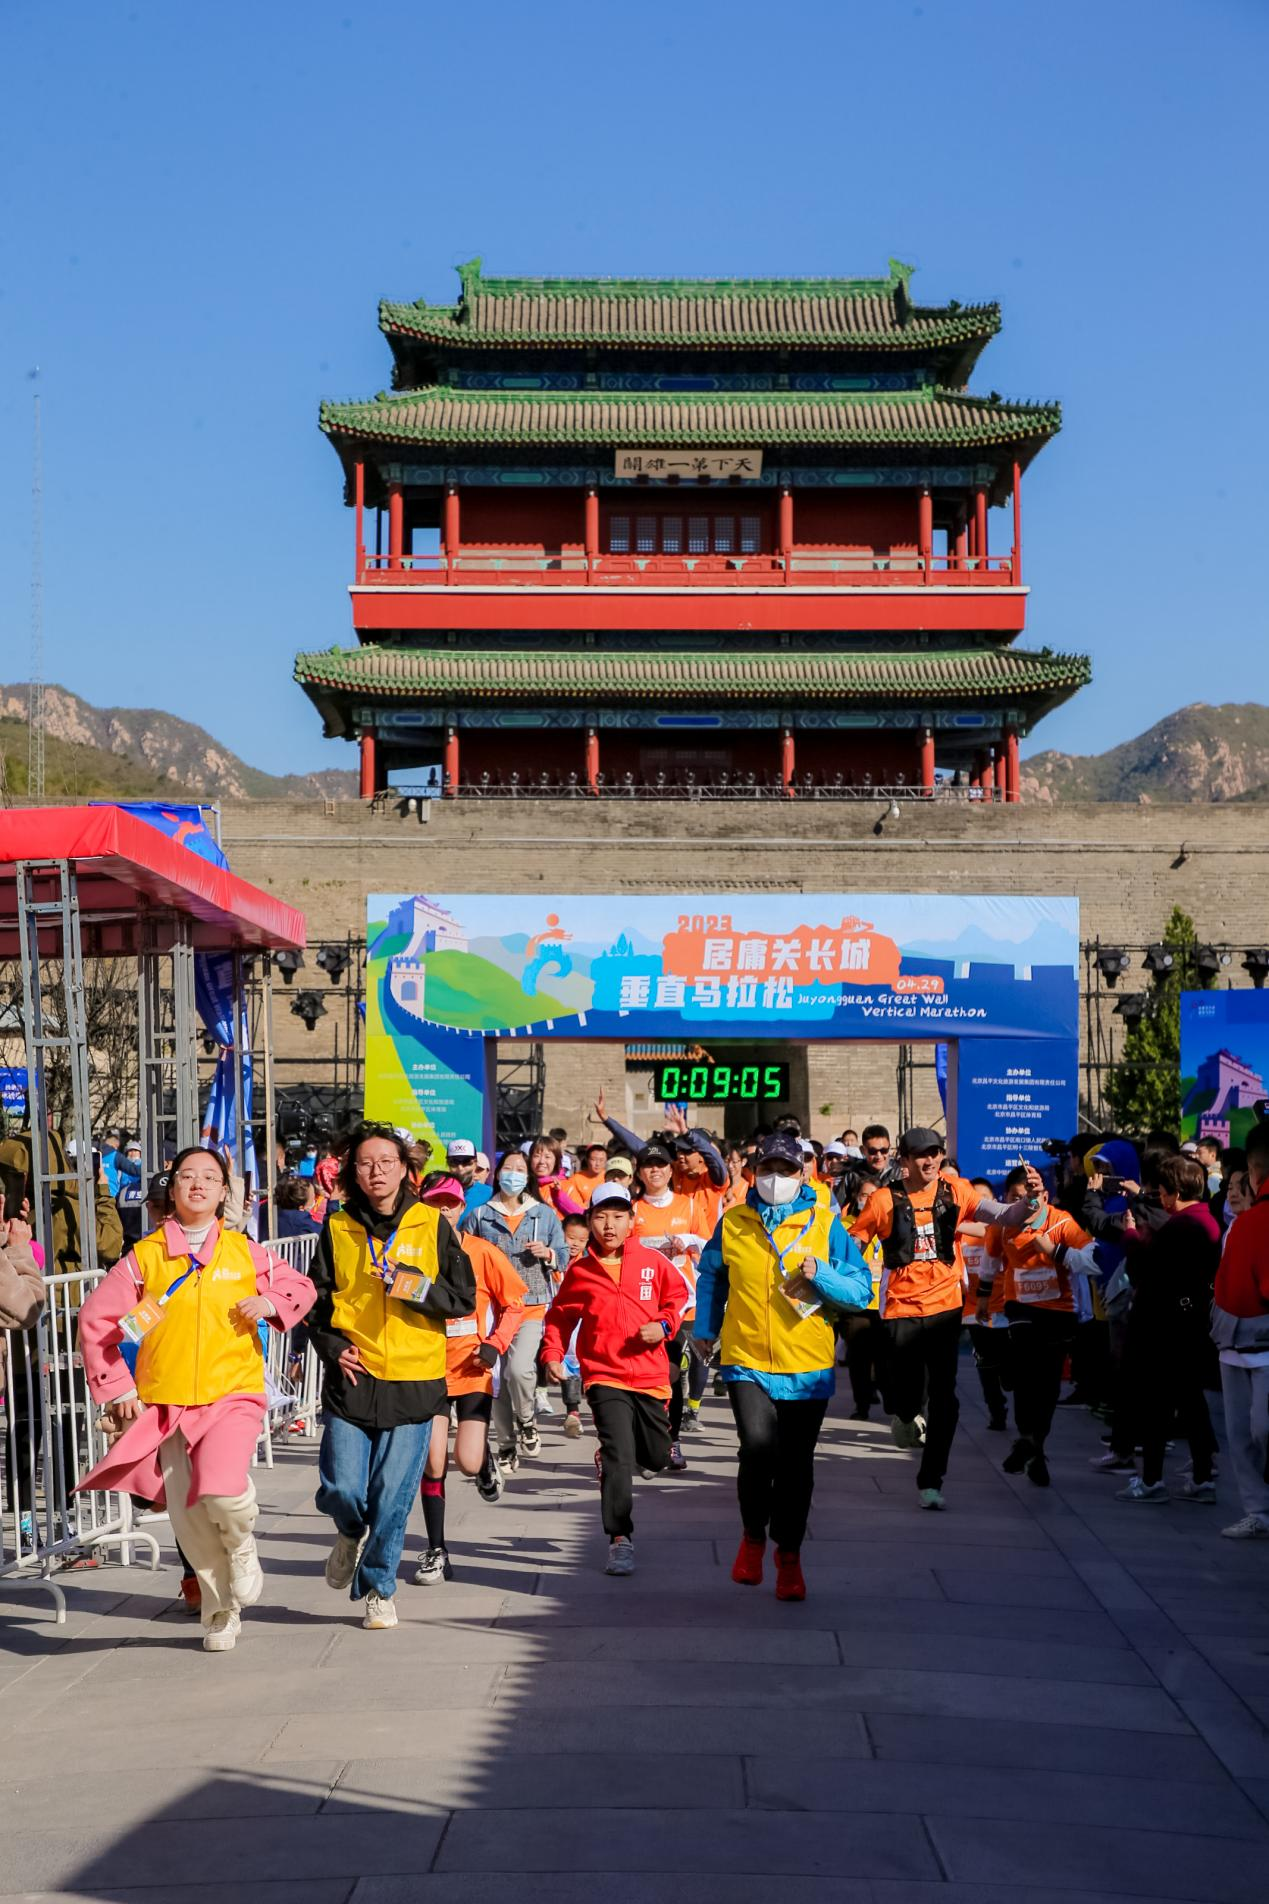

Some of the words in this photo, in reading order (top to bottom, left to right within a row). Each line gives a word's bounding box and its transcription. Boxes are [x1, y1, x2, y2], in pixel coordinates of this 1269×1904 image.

[678, 915, 732, 933] 2023
[702, 938, 871, 971] 居庸关长城
[619, 975, 794, 1009] 垂直马拉松
[896, 978, 939, 990] 04.29
[798, 994, 874, 1007] Juyongguan
[878, 994, 918, 1005] Great
[921, 993, 949, 1005] Wall
[862, 1006, 917, 1017] Vertical
[920, 1006, 987, 1018] Marathon
[1006, 1068, 1032, 1076] 主办单位
[661, 1067, 781, 1098] 0:09:05
